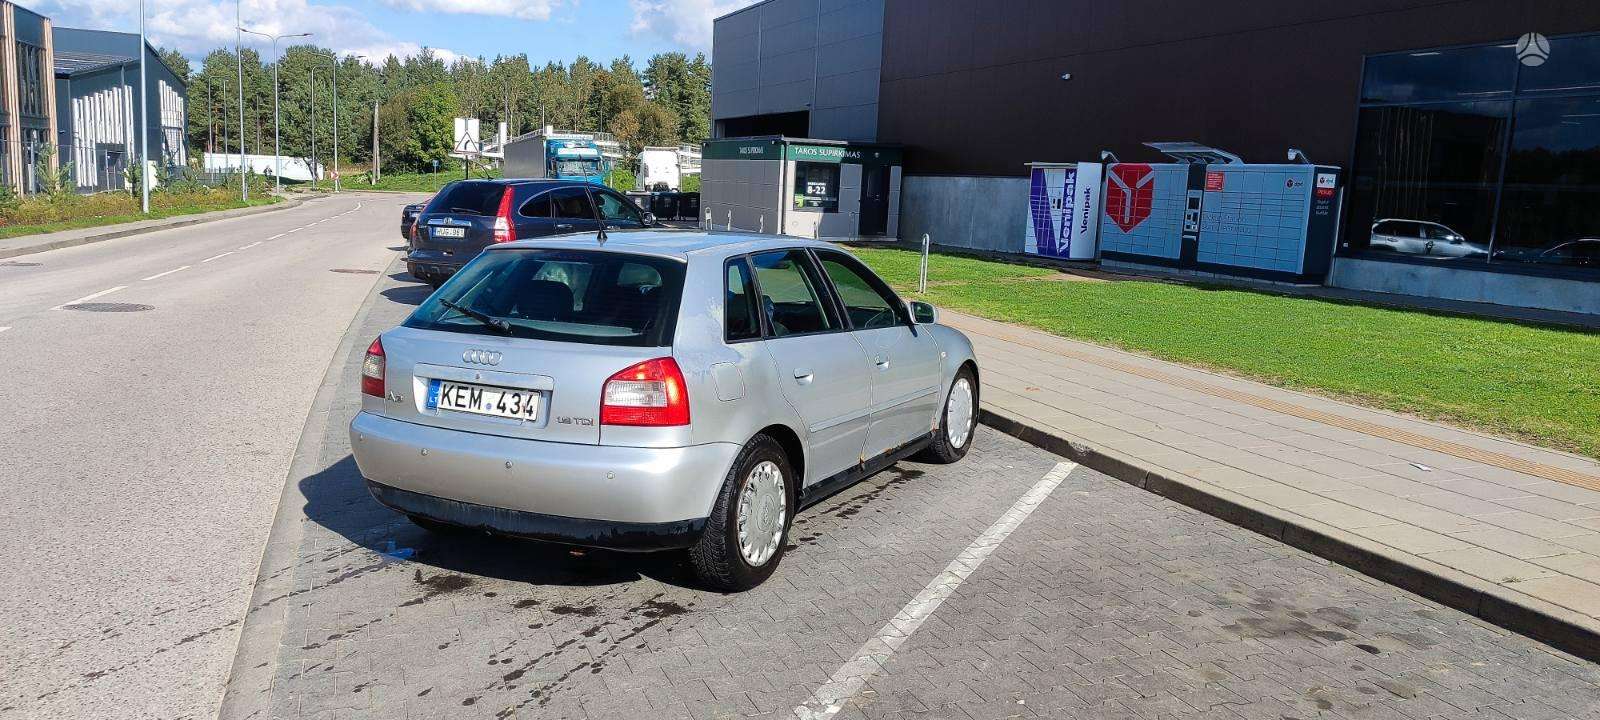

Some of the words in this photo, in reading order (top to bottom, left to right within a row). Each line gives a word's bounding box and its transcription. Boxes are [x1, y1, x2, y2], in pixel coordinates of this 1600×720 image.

[794, 147, 817, 156] TAROS
[819, 148, 861, 159] SUPIRKIMAS
[807, 185, 826, 195] 8-22
[1058, 171, 1076, 253] Venipak
[1080, 185, 1091, 234] Venipak
[441, 383, 484, 411] KEM
[496, 391, 534, 418] 434
